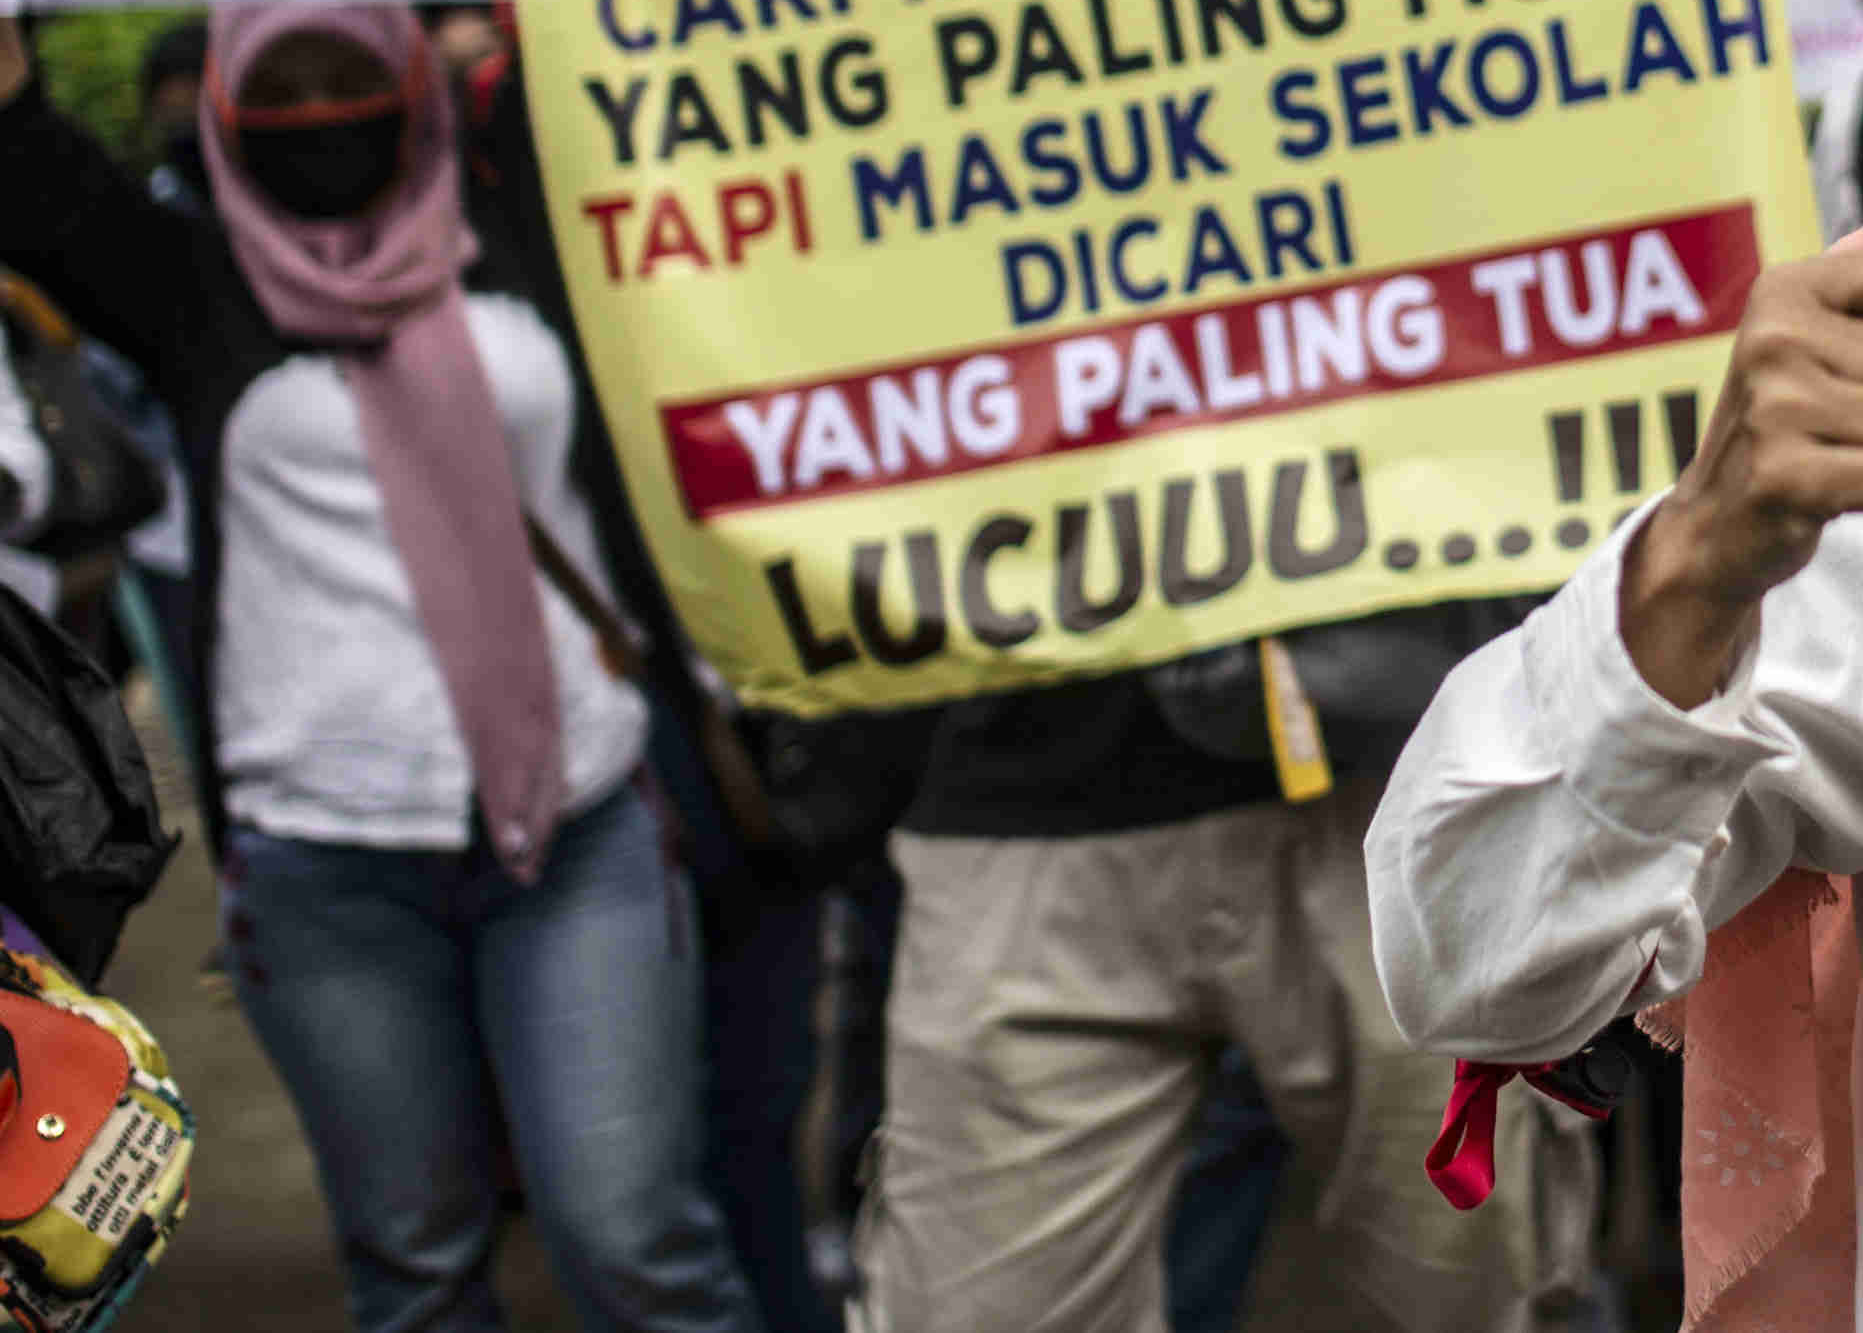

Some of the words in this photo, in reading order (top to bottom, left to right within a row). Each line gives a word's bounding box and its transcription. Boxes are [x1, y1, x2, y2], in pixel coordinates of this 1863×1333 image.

[582, 33, 890, 165] YANG
[581, 171, 813, 286] TAPI
[849, 88, 1231, 243] MASUK
[1001, 178, 1356, 327] DICARI
[723, 354, 1021, 496] YANG
[1052, 273, 1445, 437] PALING
[1470, 226, 1707, 356] TUA
